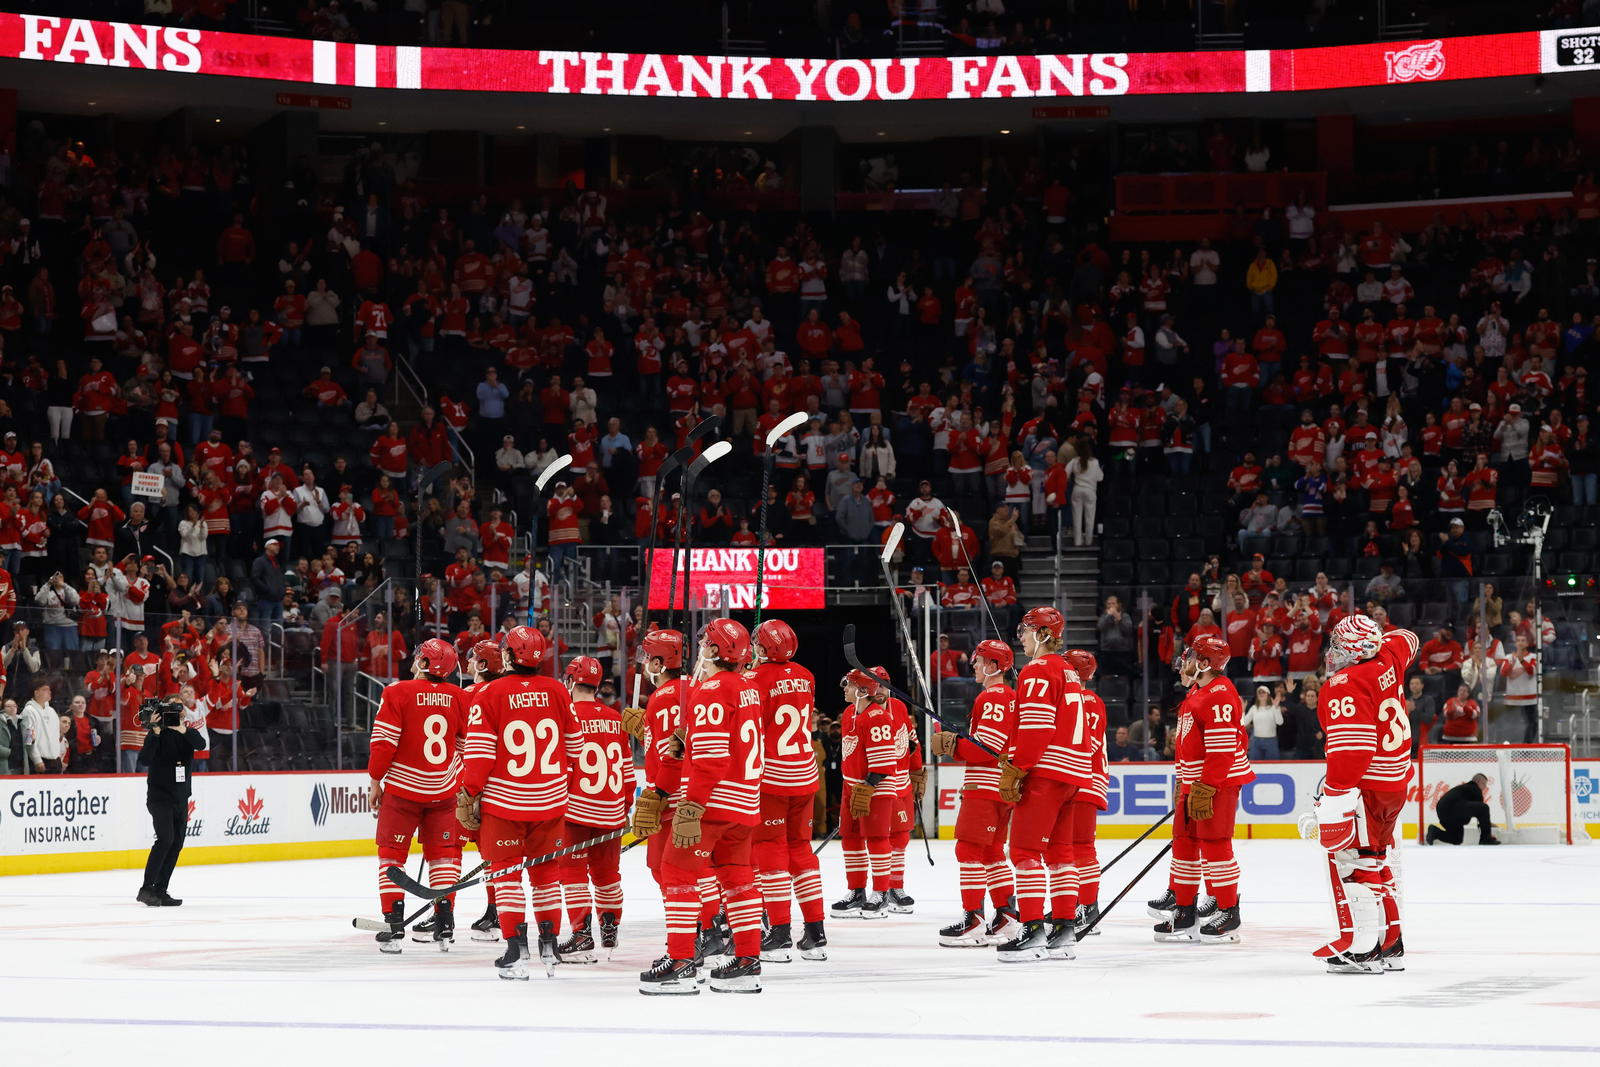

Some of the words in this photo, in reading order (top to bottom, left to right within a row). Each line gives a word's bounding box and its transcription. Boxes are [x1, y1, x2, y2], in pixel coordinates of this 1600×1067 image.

[19, 14, 202, 74] FANS
[1561, 35, 1600, 49] SHOTS
[1573, 48, 1595, 64] 32
[538, 50, 773, 100] THANK
[784, 57, 920, 102] YOU
[946, 52, 1130, 99] FANS
[416, 692, 453, 708] CHIAROT
[1024, 678, 1049, 698] 77
[508, 692, 549, 710] KASPER
[981, 702, 1005, 722] 25
[1328, 696, 1356, 720] 36
[655, 705, 681, 732] 72
[694, 703, 725, 727] 20
[1064, 692, 1084, 744] 7
[1212, 704, 1233, 723] 18
[423, 714, 448, 765] 8
[774, 704, 814, 756] 21
[870, 725, 892, 742] 88
[503, 718, 561, 777] 92
[740, 717, 765, 780] 2
[579, 742, 623, 794] 93
[10, 790, 109, 822] Gallagher
[331, 786, 379, 819] Michi
[1097, 773, 1296, 816] GEO
[24, 825, 95, 843] INSURANCE
[224, 814, 271, 836] Labatt
[764, 818, 785, 826] CCM
[496, 839, 519, 847] CCM
